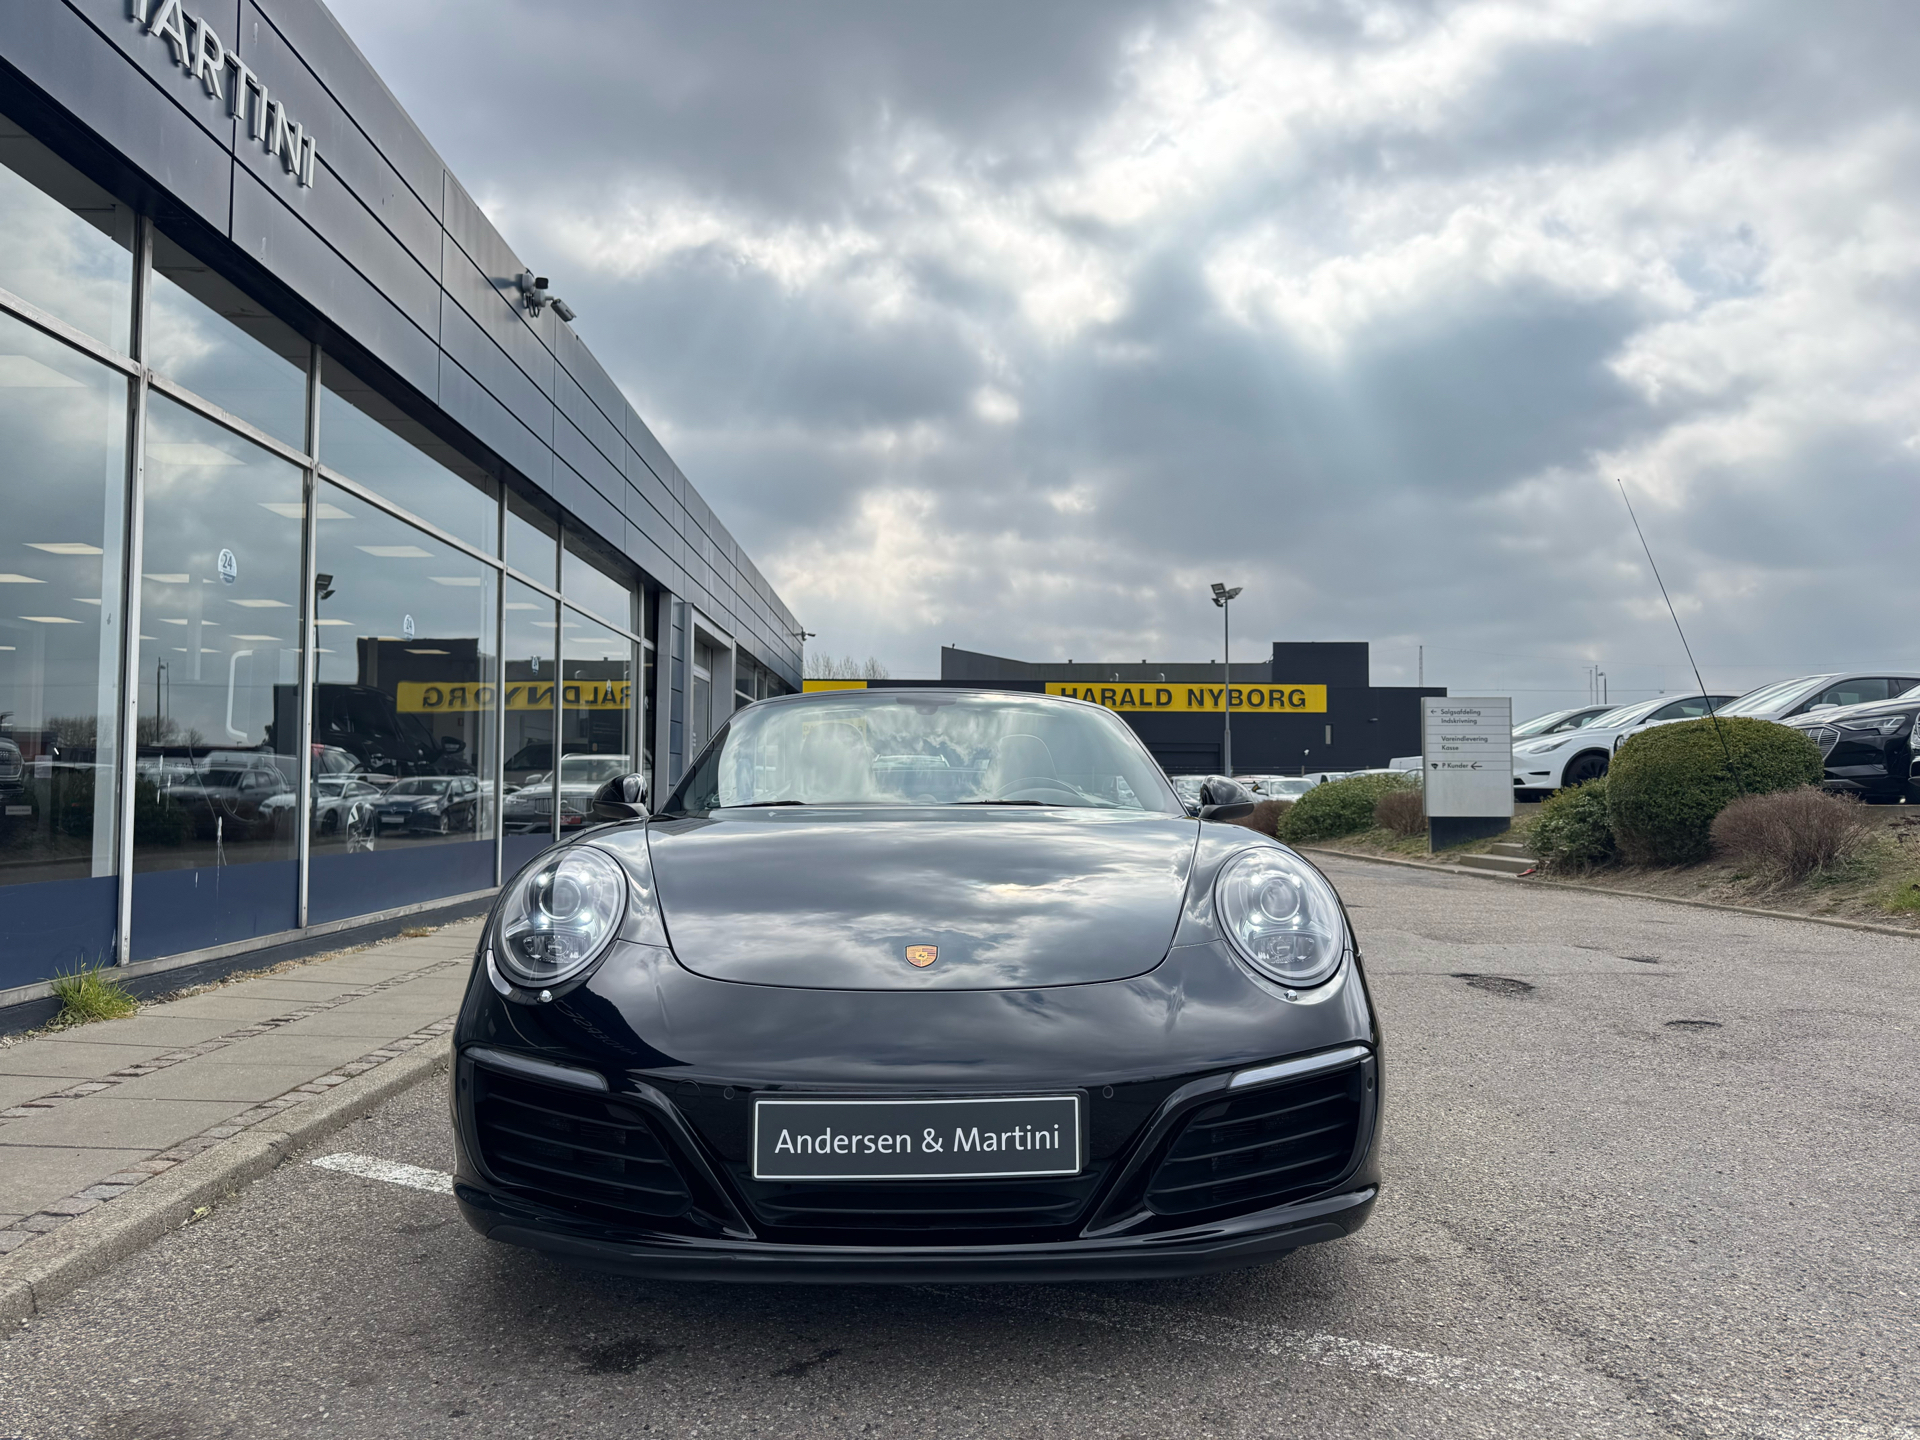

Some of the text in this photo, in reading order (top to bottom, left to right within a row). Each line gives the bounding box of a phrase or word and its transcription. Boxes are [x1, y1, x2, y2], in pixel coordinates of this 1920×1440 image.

[222, 553, 233, 570] 24
[1060, 687, 1306, 708] HARALD NYBORG
[774, 1124, 1060, 1154] Andersen & Martini
